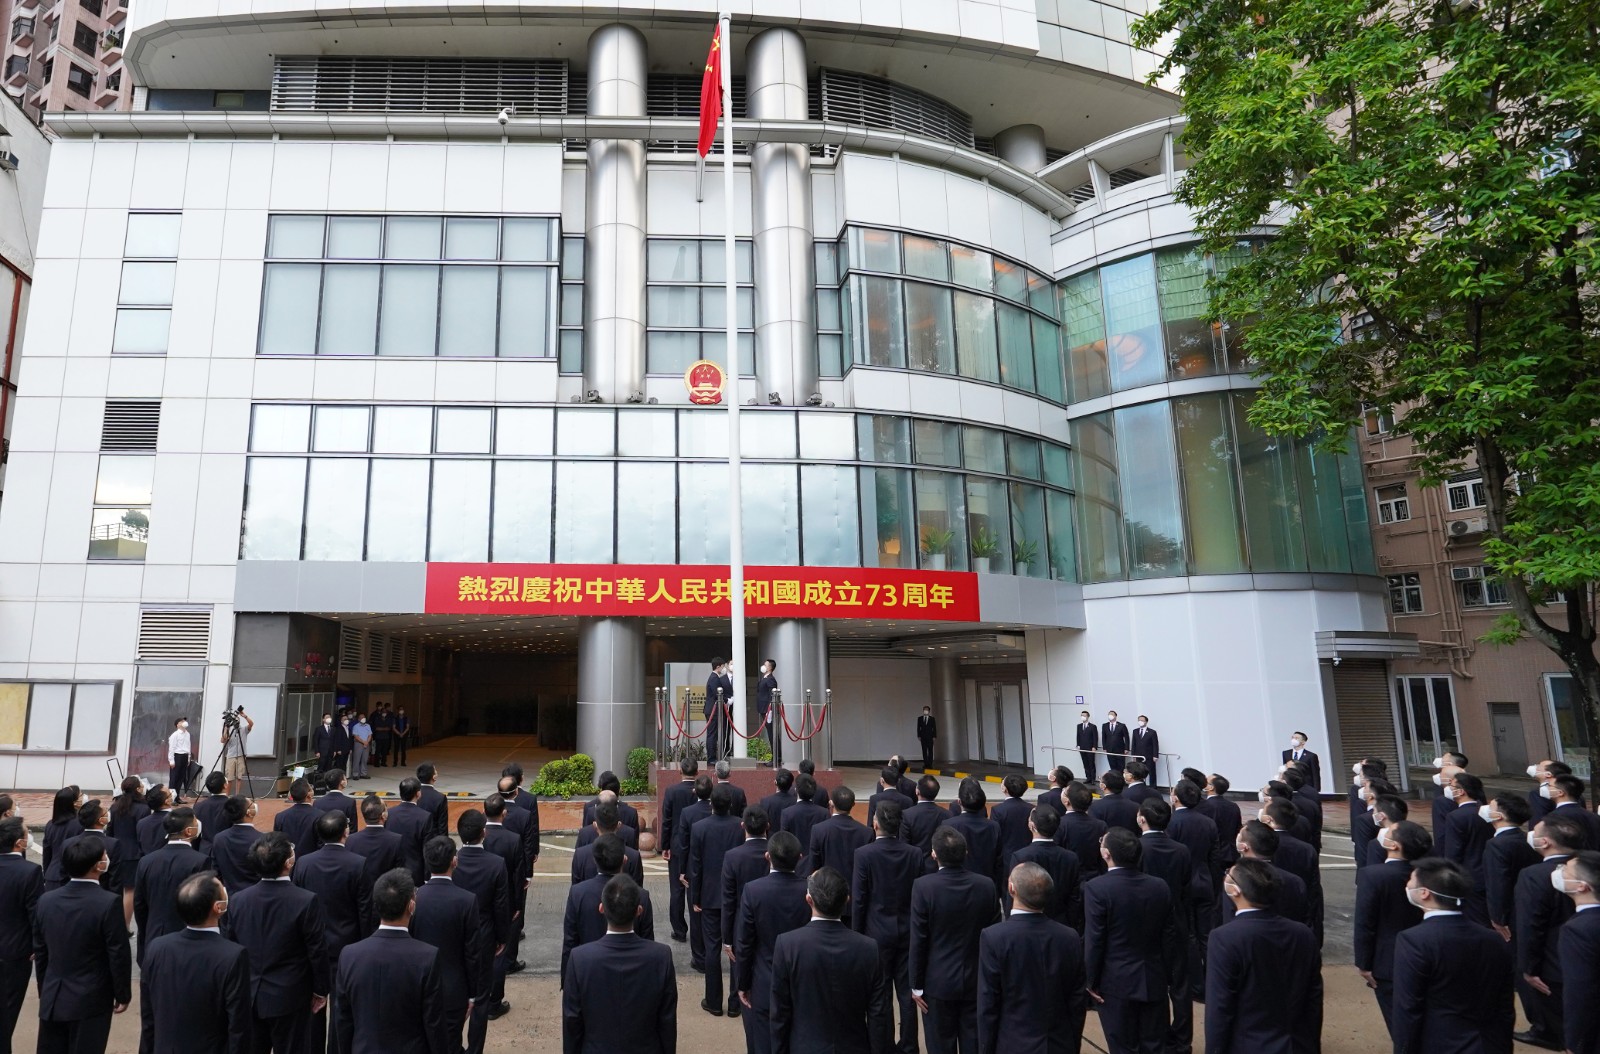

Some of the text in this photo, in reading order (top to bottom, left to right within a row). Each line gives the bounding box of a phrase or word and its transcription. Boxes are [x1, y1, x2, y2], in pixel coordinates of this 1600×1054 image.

[458, 575, 955, 608] 熱烈慶祝中華人民共和國成立73周年
